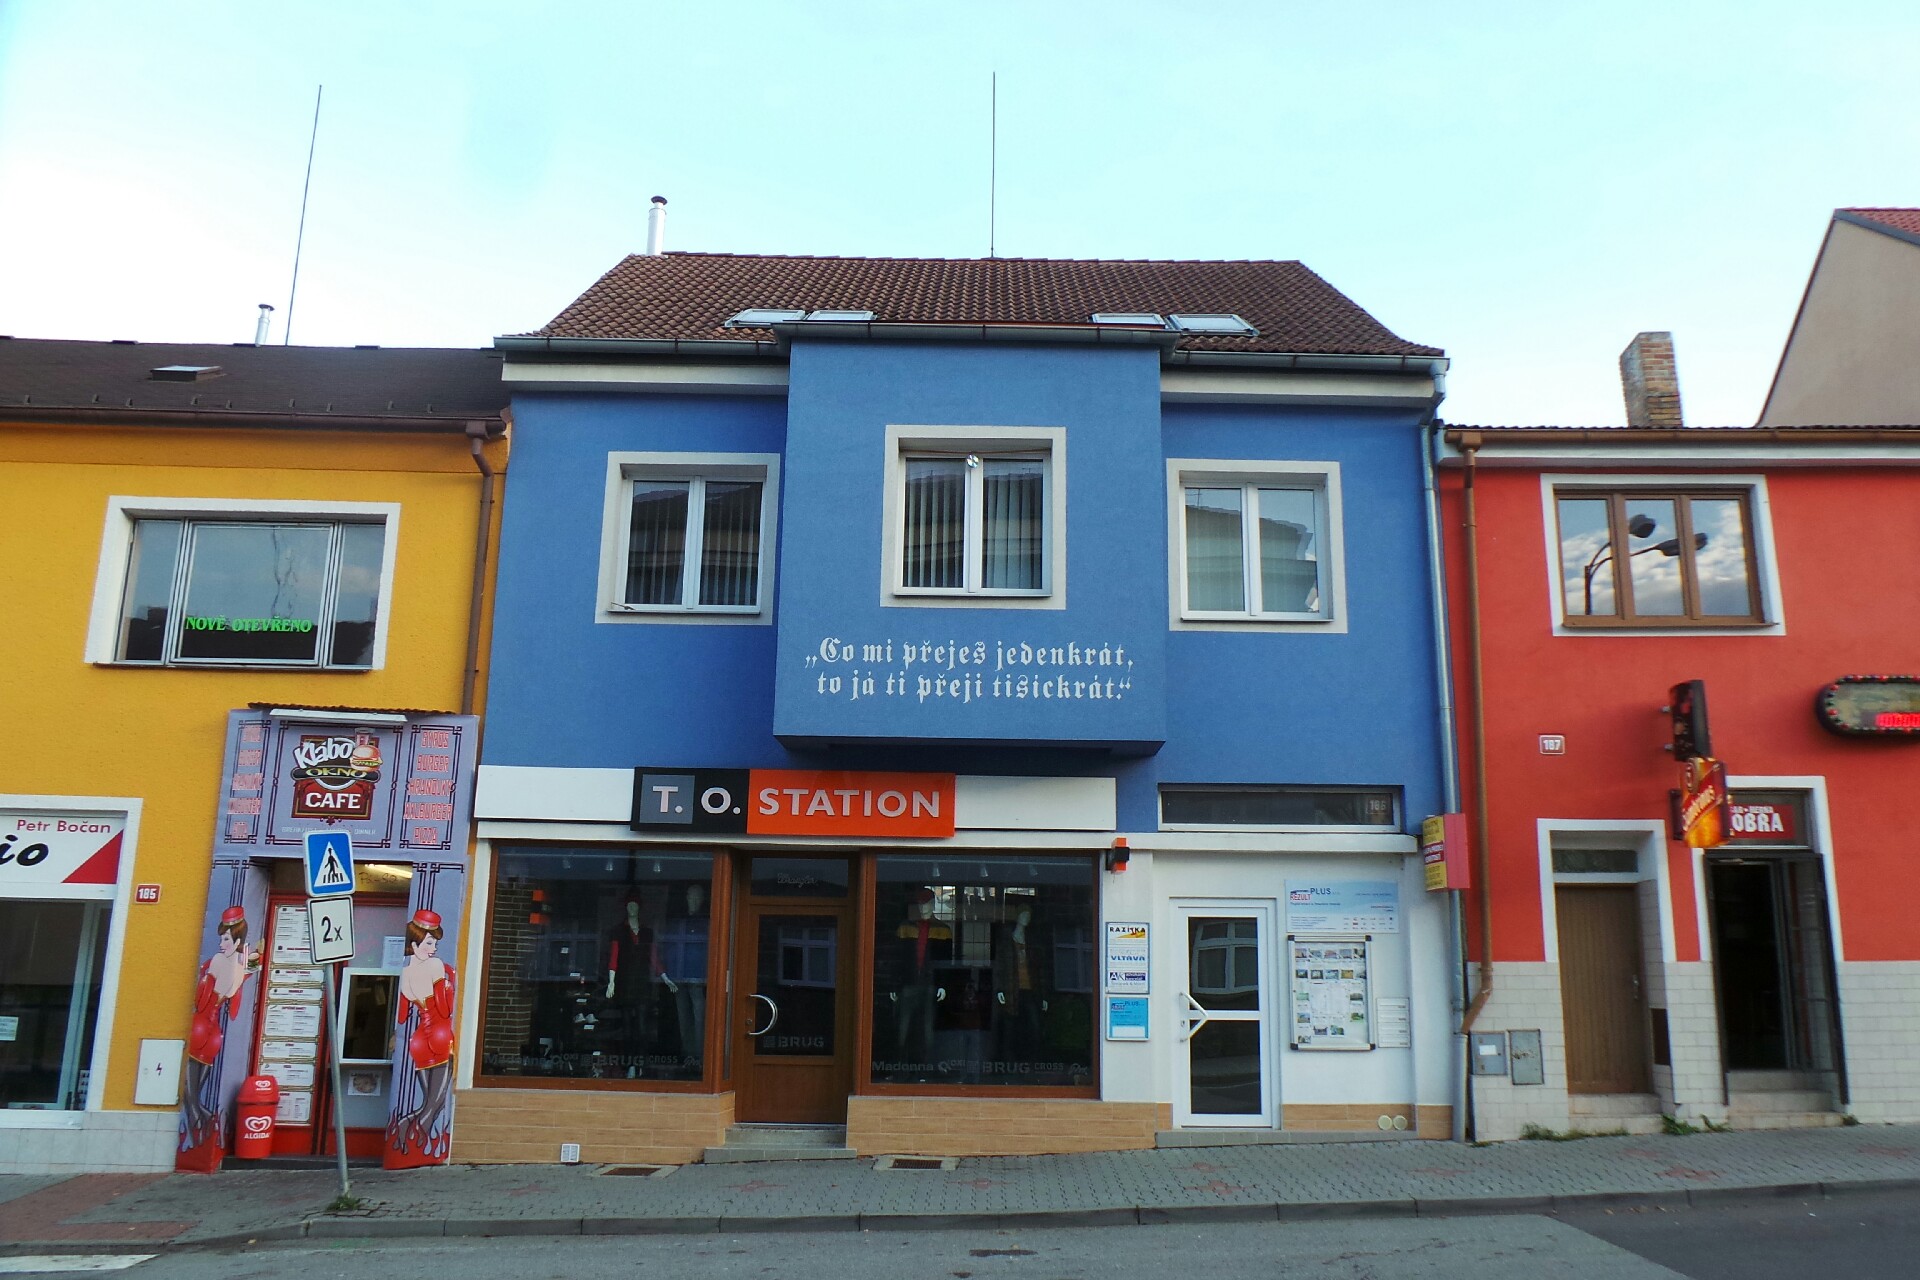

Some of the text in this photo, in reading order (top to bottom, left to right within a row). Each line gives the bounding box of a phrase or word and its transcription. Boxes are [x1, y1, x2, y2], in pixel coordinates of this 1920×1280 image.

[185, 615, 312, 632] NOVĚ OTEVŘENO
[862, 638, 893, 664] mi
[902, 639, 986, 670] přeješ
[995, 639, 1134, 672] jedenkrát,
[817, 671, 842, 695] to
[850, 669, 875, 701] já
[885, 671, 906, 696] ti
[916, 672, 983, 704] přeji
[1543, 739, 1561, 750] 187
[416, 754, 449, 772] BURGER
[305, 767, 367, 778] OKNO
[305, 792, 362, 809] CAFE
[758, 787, 940, 818] STATION
[16, 819, 111, 833] Petr Bočan
[138, 887, 157, 899] 185
[1310, 887, 1332, 895] PLUS
[778, 1036, 824, 1048] BRUG
[871, 1061, 934, 1072] Madonna
[982, 1062, 1031, 1073] BRUG
[1034, 1062, 1064, 1071] CROSS
